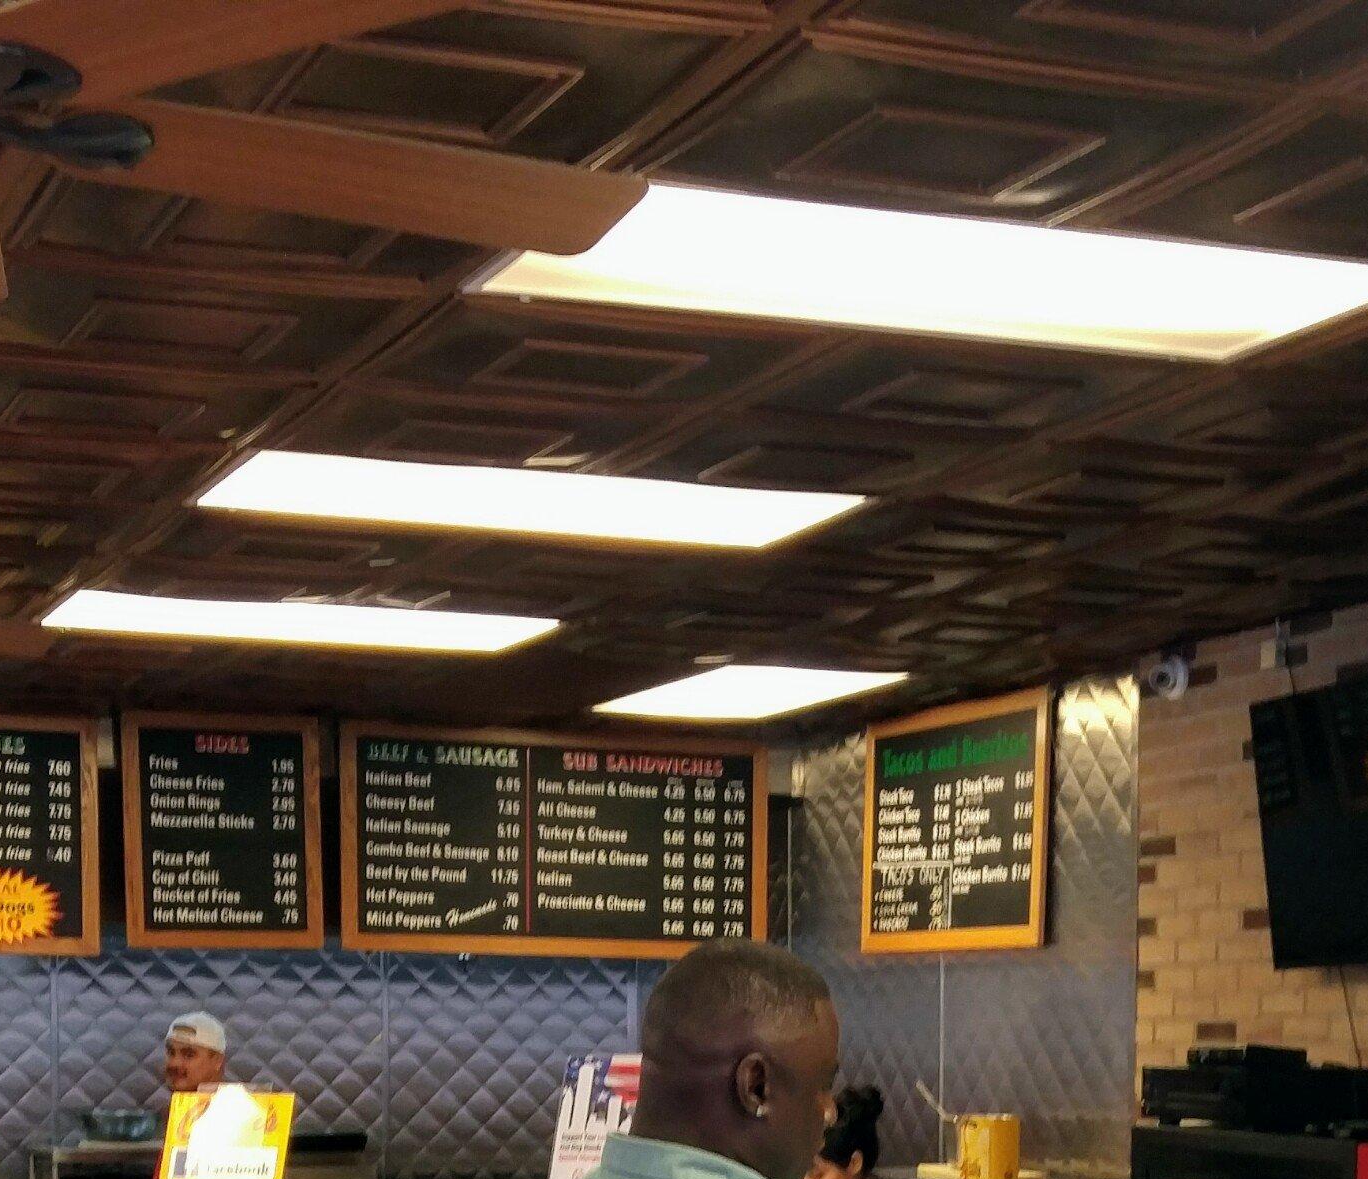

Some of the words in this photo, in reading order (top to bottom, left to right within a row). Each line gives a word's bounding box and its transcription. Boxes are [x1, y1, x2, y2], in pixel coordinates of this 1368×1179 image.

[149, 754, 179, 771] Fries
[435, 746, 519, 767] SAUSAGE
[563, 752, 598, 772] SUB
[606, 753, 724, 777] SANDWICHES
[4, 759, 30, 774] fries
[149, 774, 193, 791] Cheese
[196, 774, 225, 791] Fries
[366, 770, 402, 787] Italian
[405, 771, 432, 788] Beef
[5, 782, 31, 796] fries
[567, 779, 605, 796] Salami
[618, 782, 659, 799] Cheese
[5, 803, 31, 818] fries
[150, 793, 185, 809] Onion
[188, 794, 220, 812] Rings
[366, 793, 406, 813] Cheesy
[409, 795, 435, 811] Beef
[537, 801, 554, 817] All
[556, 801, 596, 819] Cheese
[151, 812, 215, 829] Mozzarella
[218, 813, 255, 830] Sticks
[366, 817, 401, 834] Italian
[404, 818, 451, 838] Sausage
[6, 825, 31, 839] fries
[538, 824, 574, 844] Turkey
[588, 826, 628, 844] Cheese
[6, 846, 32, 861] fries
[366, 841, 403, 857] Combo
[405, 842, 431, 858] Beef
[444, 843, 490, 863] Sausage
[536, 847, 568, 864] Roast
[570, 848, 596, 865] Beef
[609, 850, 649, 867] Cheese
[192, 870, 220, 886] Chili
[366, 863, 392, 880] Beef
[431, 866, 468, 883] Pound
[536, 870, 573, 887] Italian
[153, 888, 195, 904] Bucket
[212, 889, 241, 905] Fries
[388, 888, 435, 907] Peppers
[537, 892, 593, 910] Prosciutto
[607, 894, 646, 913] Cheese
[177, 908, 218, 924] Melted
[220, 909, 264, 924] Cheese
[395, 910, 442, 930] Peppers
